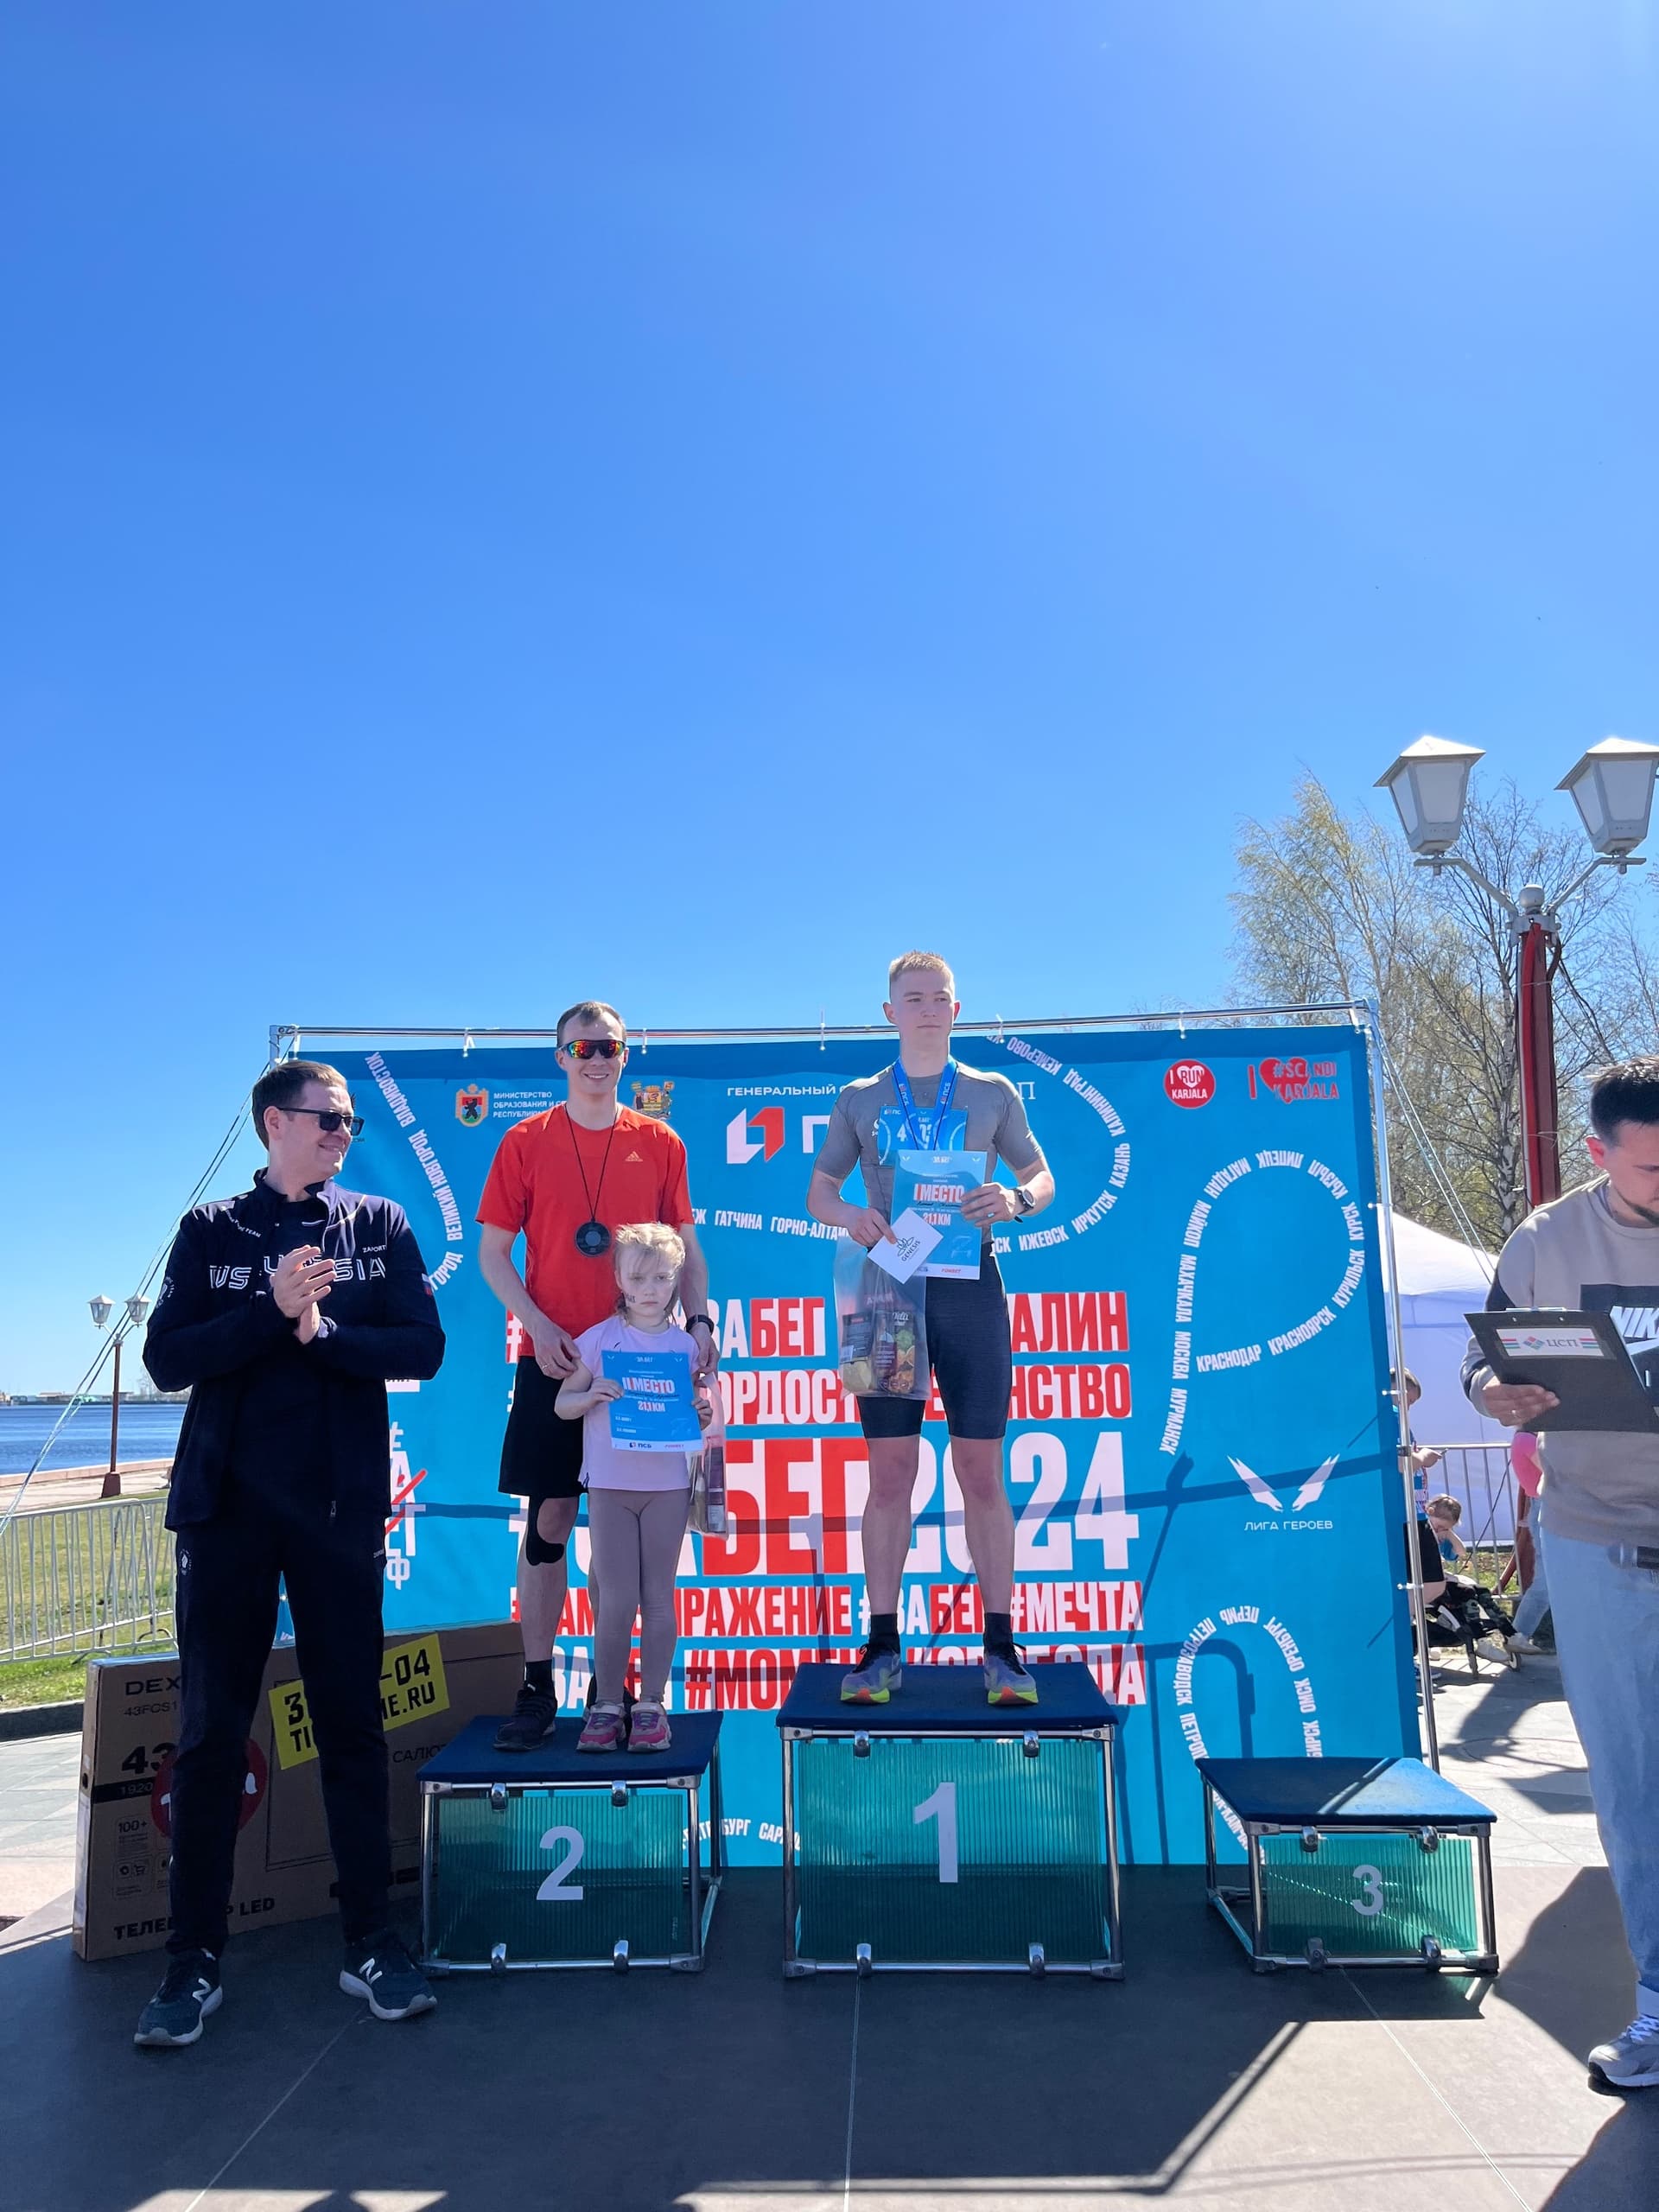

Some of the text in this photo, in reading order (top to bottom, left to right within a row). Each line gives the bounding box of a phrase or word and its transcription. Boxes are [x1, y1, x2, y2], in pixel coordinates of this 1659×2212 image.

[1007, 1037, 1063, 1076] КЕМЕРОВО
[365, 1052, 416, 1128] ВЛАДИВОСТОК
[727, 1084, 836, 1096] ГЕНЕРАЛЬНЫЙ
[1063, 1068, 1126, 1137] КАЛИНИНГРАД
[1172, 1088, 1208, 1099] KARJALA
[1109, 1142, 1131, 1188] КАЗАНЬ
[1204, 1157, 1251, 1198] МАГАДАН
[1307, 1160, 1349, 1200] КЫЗЫЛ
[433, 1185, 463, 1242] ВЕЛИКИЙ
[921, 1184, 965, 1204] МЕСТО
[1071, 1192, 1118, 1235] ИРКУТСК
[715, 1211, 762, 1230] ГАТЧИНА
[1018, 1225, 1069, 1252] ИЖЕВСК
[1183, 1200, 1211, 1248] МАЙКОП
[1341, 1202, 1364, 1241] КУРСК
[429, 1251, 464, 1291] ГОРОД
[901, 1240, 921, 1262] GENESIS
[1175, 1254, 1197, 1323] МАХАЧКАЛА
[1332, 1249, 1365, 1308] КУРИЛЬСК
[1268, 1306, 1337, 1355] КРАСНОЯРСК
[1547, 1339, 1579, 1348] ЦСП
[1173, 1331, 1191, 1380] МОСКВА
[1197, 1344, 1262, 1373] КРАСНОДАР
[634, 1377, 675, 1394] МЕСТО
[1159, 1388, 1187, 1455] МУРМАНСК
[1244, 1520, 1333, 1531] ЛИГА ГЕРОЕВ
[1220, 1605, 1259, 1625] ПЕРМЬ
[1173, 1617, 1217, 1706] ПЕТРОЗАВОДСК
[1263, 1617, 1305, 1672] ОРЕНБУРГ
[125, 1676, 181, 1695] DEX
[1294, 1677, 1316, 1713] ОМСК
[912, 1781, 958, 1884] 1
[536, 1825, 585, 1901] 2
[240, 1897, 276, 1916] LED
[1351, 1864, 1383, 1916] 3
